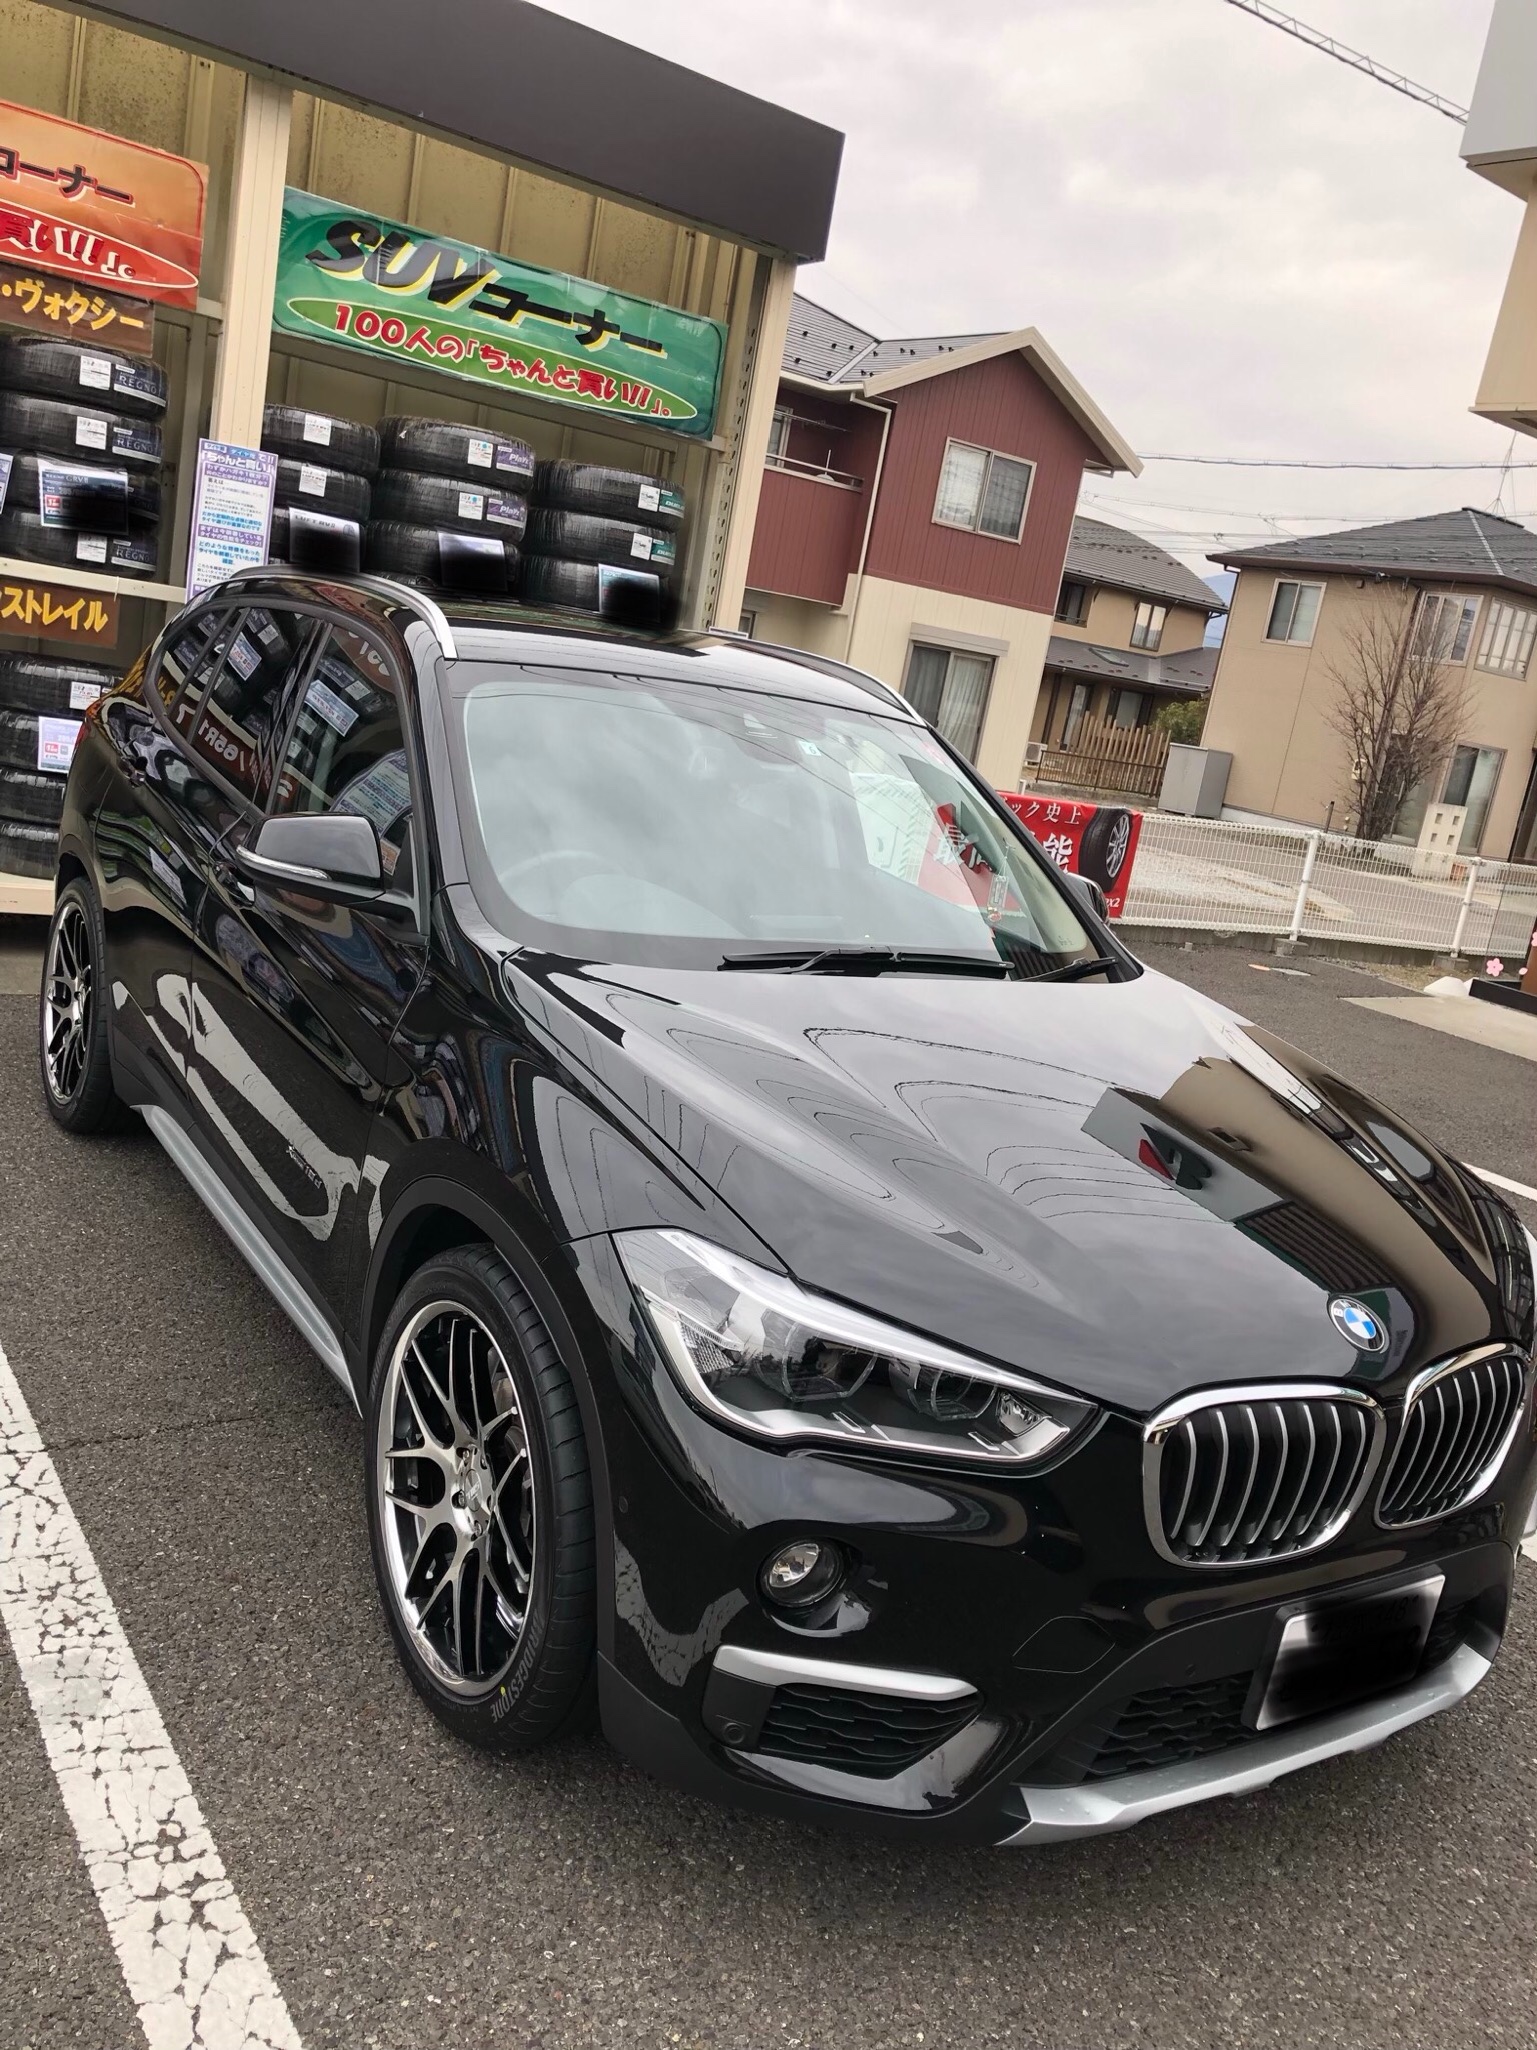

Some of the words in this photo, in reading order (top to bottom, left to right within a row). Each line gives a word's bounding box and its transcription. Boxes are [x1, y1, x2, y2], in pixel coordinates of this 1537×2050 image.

[306, 219, 667, 359] SUVコーナー
[119, 375, 157, 394] REGNO
[0, 586, 108, 633] ストレイル
